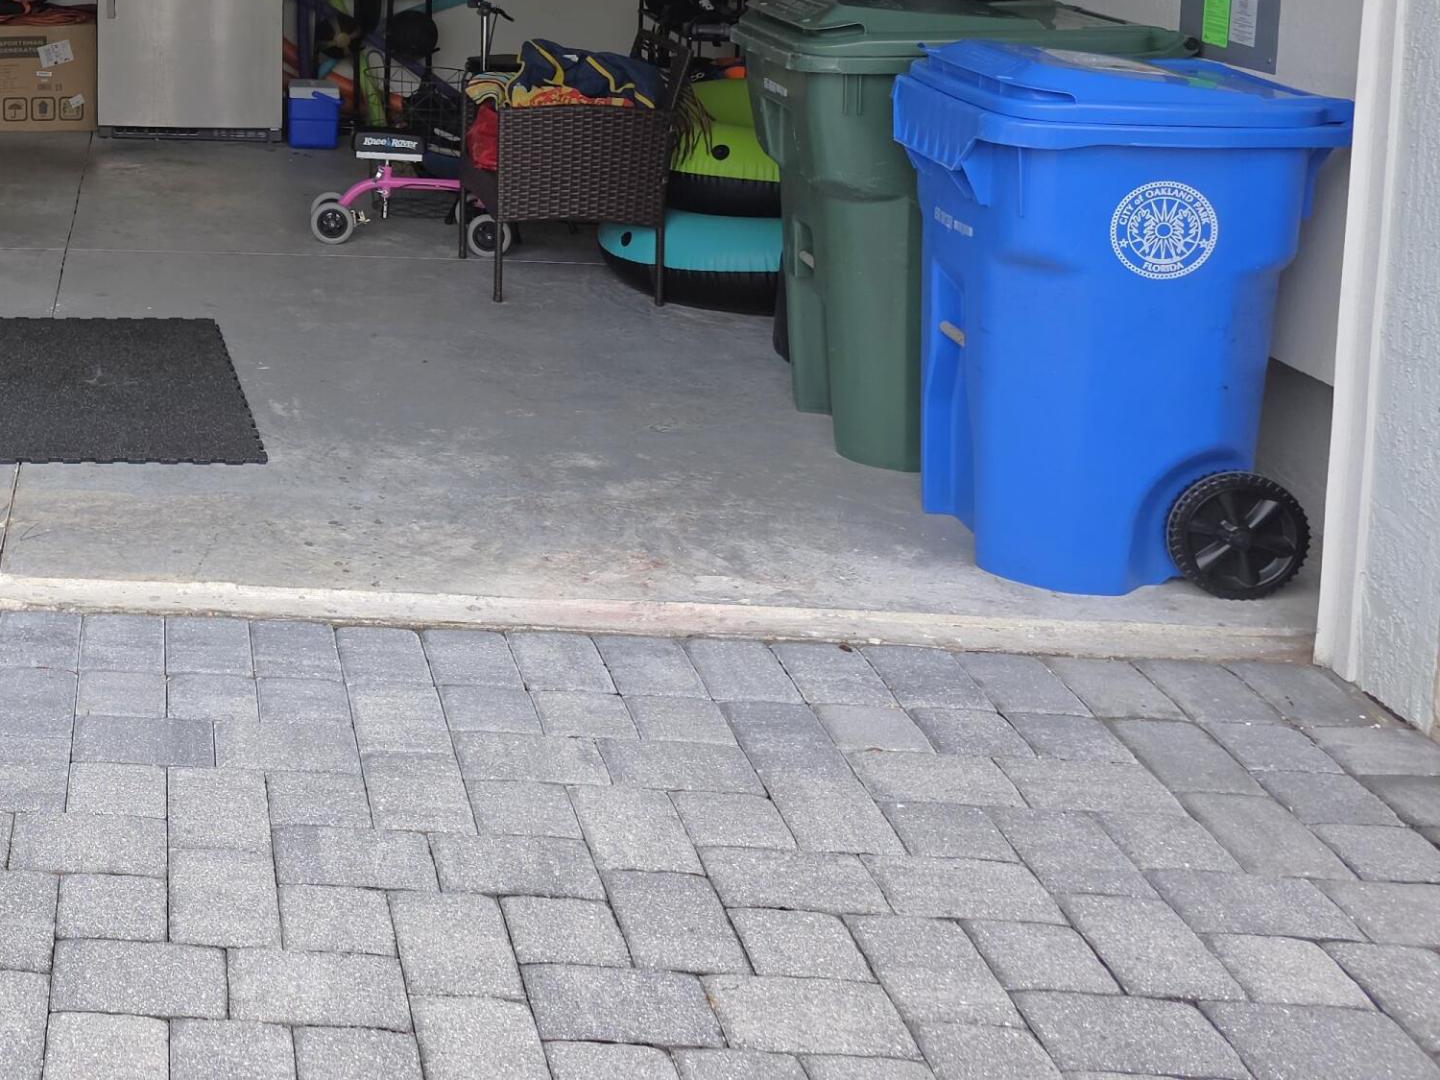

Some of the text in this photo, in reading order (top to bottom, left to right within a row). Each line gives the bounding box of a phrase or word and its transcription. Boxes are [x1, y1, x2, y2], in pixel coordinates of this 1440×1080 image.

[363, 136, 418, 150] Knee Rover
[1119, 187, 1211, 225] CITY of OAKLAND PARK
[1142, 262, 1185, 273] FLORIDA
